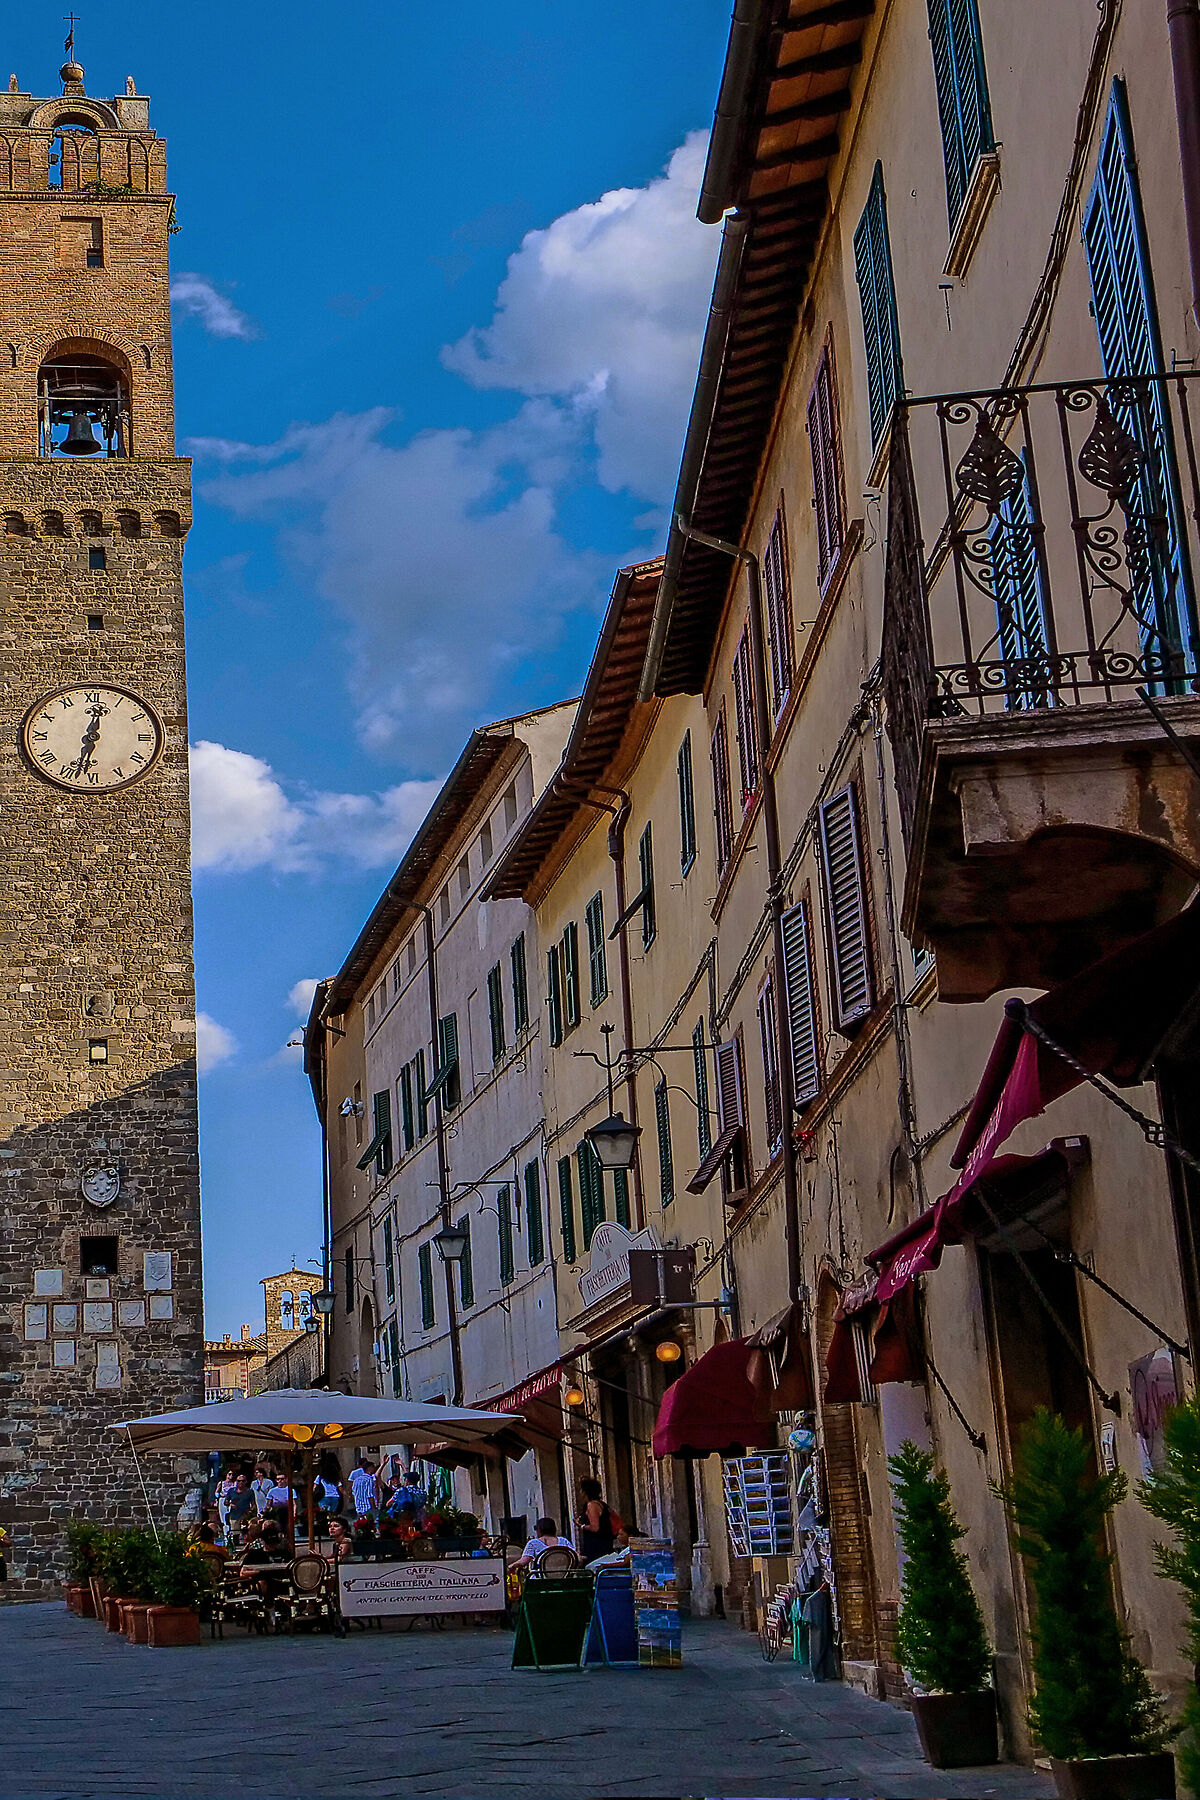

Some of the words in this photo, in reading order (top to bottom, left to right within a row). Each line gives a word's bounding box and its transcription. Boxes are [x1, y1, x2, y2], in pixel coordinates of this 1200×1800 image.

[84, 692, 100, 703] XII
[114, 696, 124, 708] I
[58, 697, 74, 710] XI
[40, 711, 55, 722] X
[130, 712, 146, 722] II
[31, 730, 48, 741] IX
[137, 733, 152, 742] III
[36, 748, 58, 767] VIII
[86, 772, 100, 783] VI
[111, 766, 124, 778] V
[364, 1579, 434, 1589] FIASCHETTERIA
[439, 1577, 480, 1587] ITALIANA
